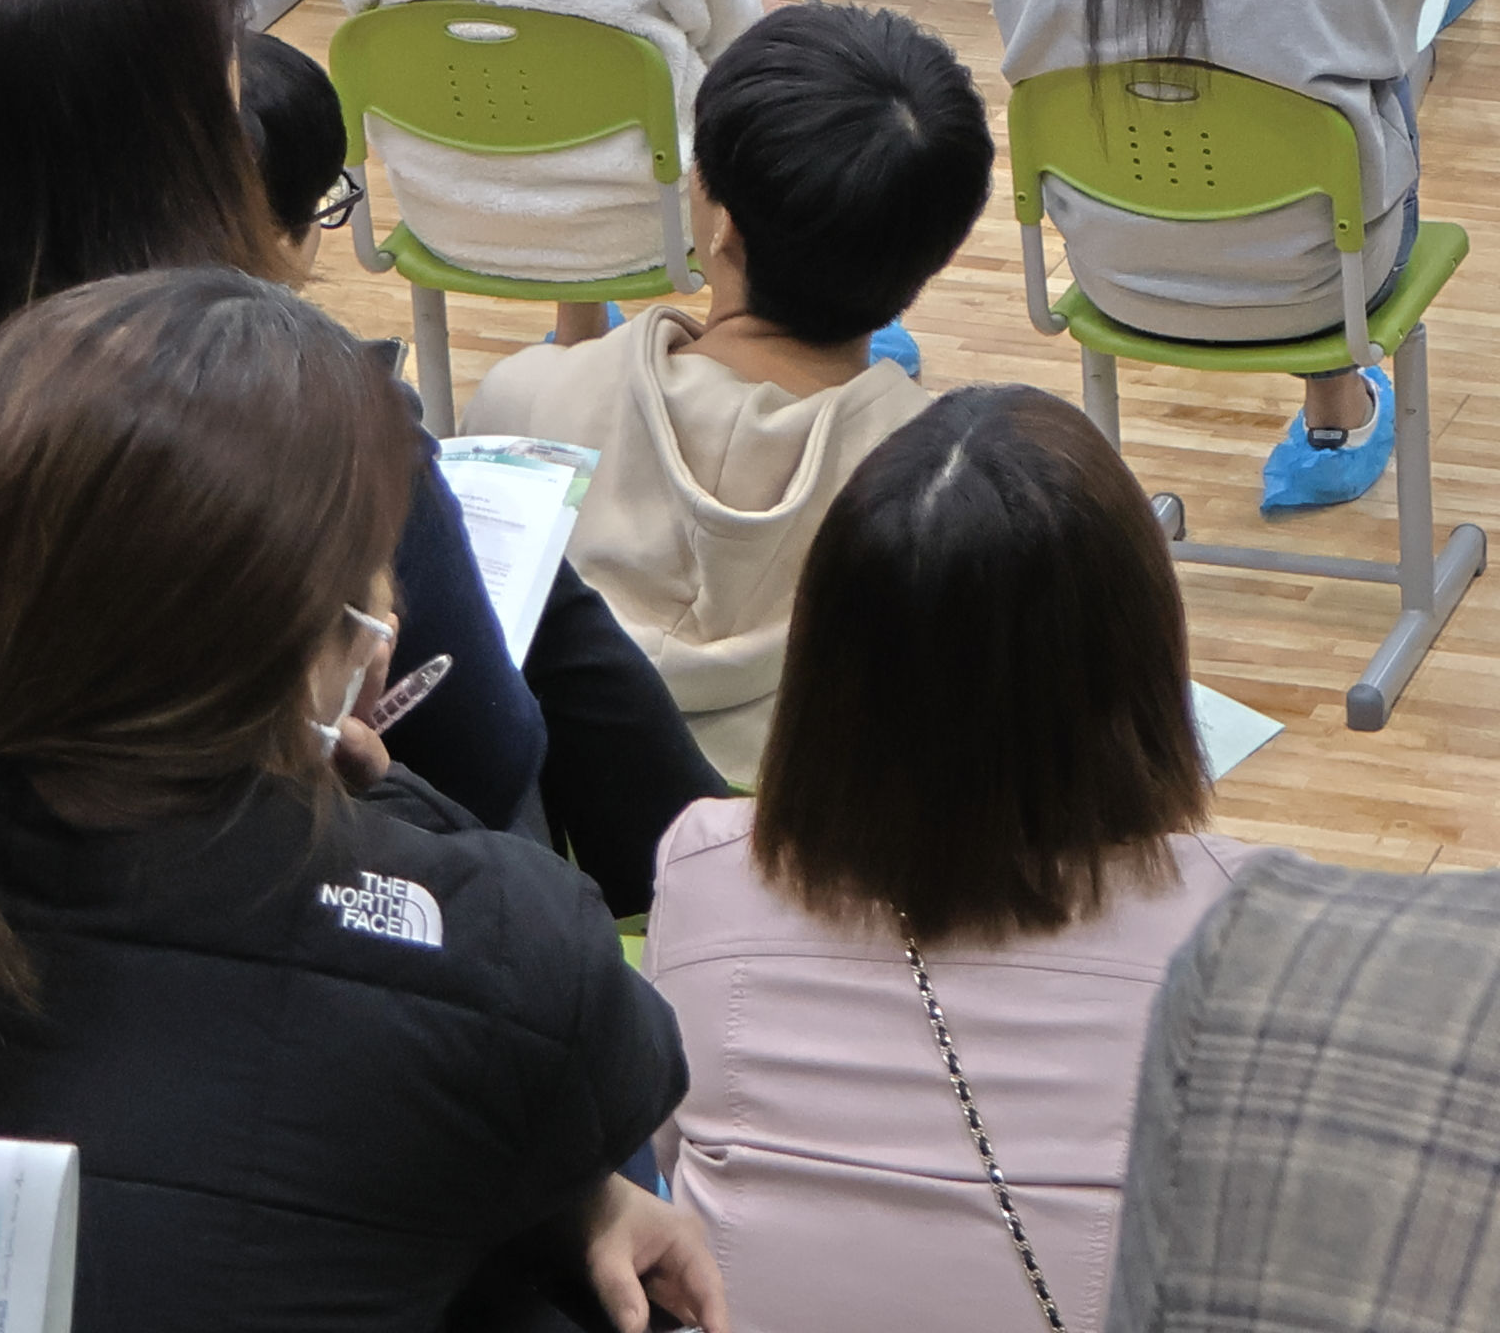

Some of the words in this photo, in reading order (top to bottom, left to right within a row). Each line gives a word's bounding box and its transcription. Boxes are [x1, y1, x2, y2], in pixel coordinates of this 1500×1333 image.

[359, 870, 408, 900] THE
[318, 883, 405, 918] NORTH
[341, 908, 402, 938] FACE
